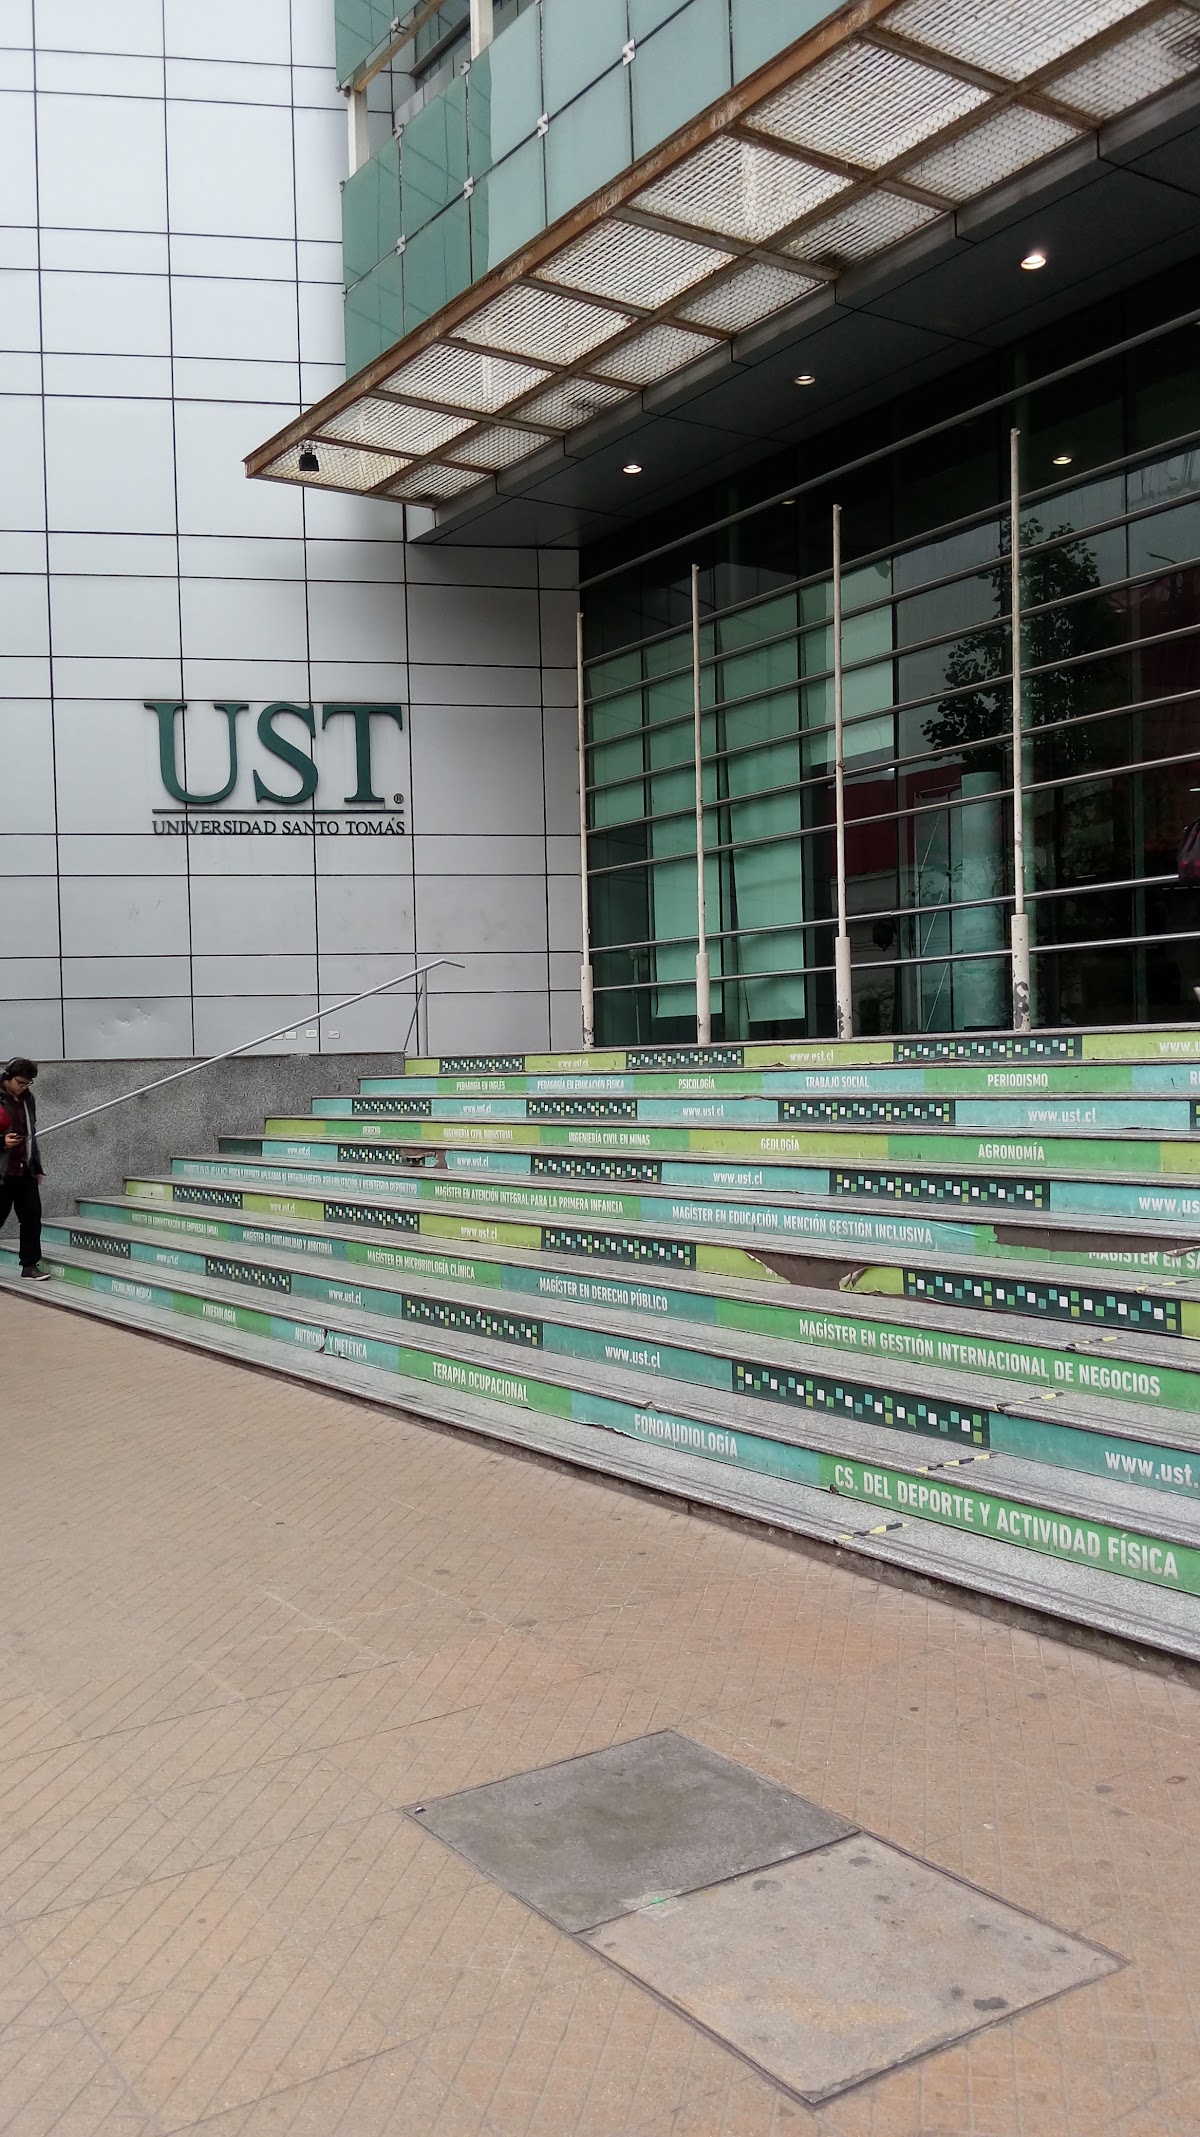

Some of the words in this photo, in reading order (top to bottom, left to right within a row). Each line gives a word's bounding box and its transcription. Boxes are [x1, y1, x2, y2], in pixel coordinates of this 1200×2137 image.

[152, 819, 276, 835] UNIVERSIDAD
[281, 820, 339, 835] SANTO
[345, 817, 405, 835] TOMÁS
[557, 1058, 589, 1068] www.ust.cl
[789, 1050, 834, 1062] www.ust.cl
[456, 1078, 481, 1091] PEDAGOGÍA
[482, 1081, 489, 1091] EN
[490, 1078, 506, 1090] INGLÉS
[537, 1077, 566, 1090] PEDAGOGÍA
[566, 1080, 575, 1090] EN
[575, 1077, 605, 1090] EDUCACIÓN
[606, 1076, 625, 1089] FÍSICA
[678, 1075, 716, 1089] PSICOLOGÍA
[805, 1076, 840, 1089] TRABAJO
[841, 1076, 869, 1088] SOCIAL
[987, 1073, 1049, 1087] PERIODISMO
[462, 1103, 492, 1114] www.ust.cl
[682, 1105, 724, 1117] www.ust.cl
[1027, 1107, 1096, 1123] www.ust.cl
[443, 1126, 469, 1139] INGENIERÍA
[470, 1129, 483, 1139] CIVIL
[568, 1130, 602, 1144] INGENIERÍA
[602, 1132, 618, 1145] CIVIL
[619, 1133, 628, 1145] EN
[629, 1134, 651, 1145] MINAS
[760, 1135, 800, 1152] GEOLOGÍA
[978, 1142, 1045, 1162] AGRONOMÍA
[456, 1156, 489, 1167] www.ust.cl
[713, 1170, 763, 1185] www.ust.cl
[434, 1184, 462, 1199] MAGÍSTER
[462, 1188, 470, 1200] EN
[471, 1187, 499, 1202] ATENCIÓN
[500, 1192, 529, 1206] INTEGRAL
[530, 1194, 548, 1207] PARA
[548, 1196, 558, 1207] LA
[558, 1197, 589, 1211] PRIMERA
[590, 1199, 623, 1214] INFANCIA
[672, 1203, 713, 1221] MAGÍSTER
[715, 1210, 726, 1223] EN
[728, 1209, 781, 1230] EDUCACIÓN,
[783, 1214, 827, 1233] MENCIÓN
[829, 1218, 872, 1238] GESTIÓN
[875, 1224, 933, 1244] INCLUSIVA
[460, 1226, 498, 1240] www.ust.cl
[242, 1228, 264, 1243] MAGÍSTER
[265, 1232, 271, 1244] EN
[271, 1233, 302, 1250] CONTABILIDAD
[302, 1239, 307, 1249] Y
[307, 1240, 333, 1255] AUDITORÍA
[367, 1250, 394, 1265] MAGÍSTER
[395, 1255, 403, 1266] EN
[404, 1257, 449, 1276] MICROBIOLOGÍA
[450, 1262, 475, 1279] CLÍNICA
[328, 1288, 362, 1305] www.ust.cl
[539, 1276, 578, 1296] MAGÍSTER
[579, 1285, 590, 1299] EN
[591, 1287, 628, 1306] DERECHO
[630, 1288, 668, 1312] PÚBLICO
[328, 1335, 334, 1349] Y
[334, 1336, 367, 1359] DIETÉTICA
[605, 1345, 661, 1369] www.ust.cl
[799, 1318, 858, 1346] MAGÍSTER
[860, 1329, 877, 1347] EN
[880, 1334, 934, 1358] GESTIÓN
[938, 1344, 1049, 1377] INTERNACIONAL
[1054, 1361, 1074, 1383] DE
[1079, 1365, 1161, 1397] NEGOCIOS
[432, 1361, 467, 1386] TERAPIA
[468, 1370, 529, 1403] OCUPACIONAL
[634, 1413, 739, 1458] FONOAUDIOLOGÍA
[834, 1463, 859, 1492] CS.
[863, 1471, 893, 1502] DEL
[897, 1480, 974, 1524] DEPORTE
[979, 1500, 990, 1519] Y
[996, 1507, 1100, 1559] ACTIVIDAD
[1108, 1532, 1178, 1580] FÍSICA
